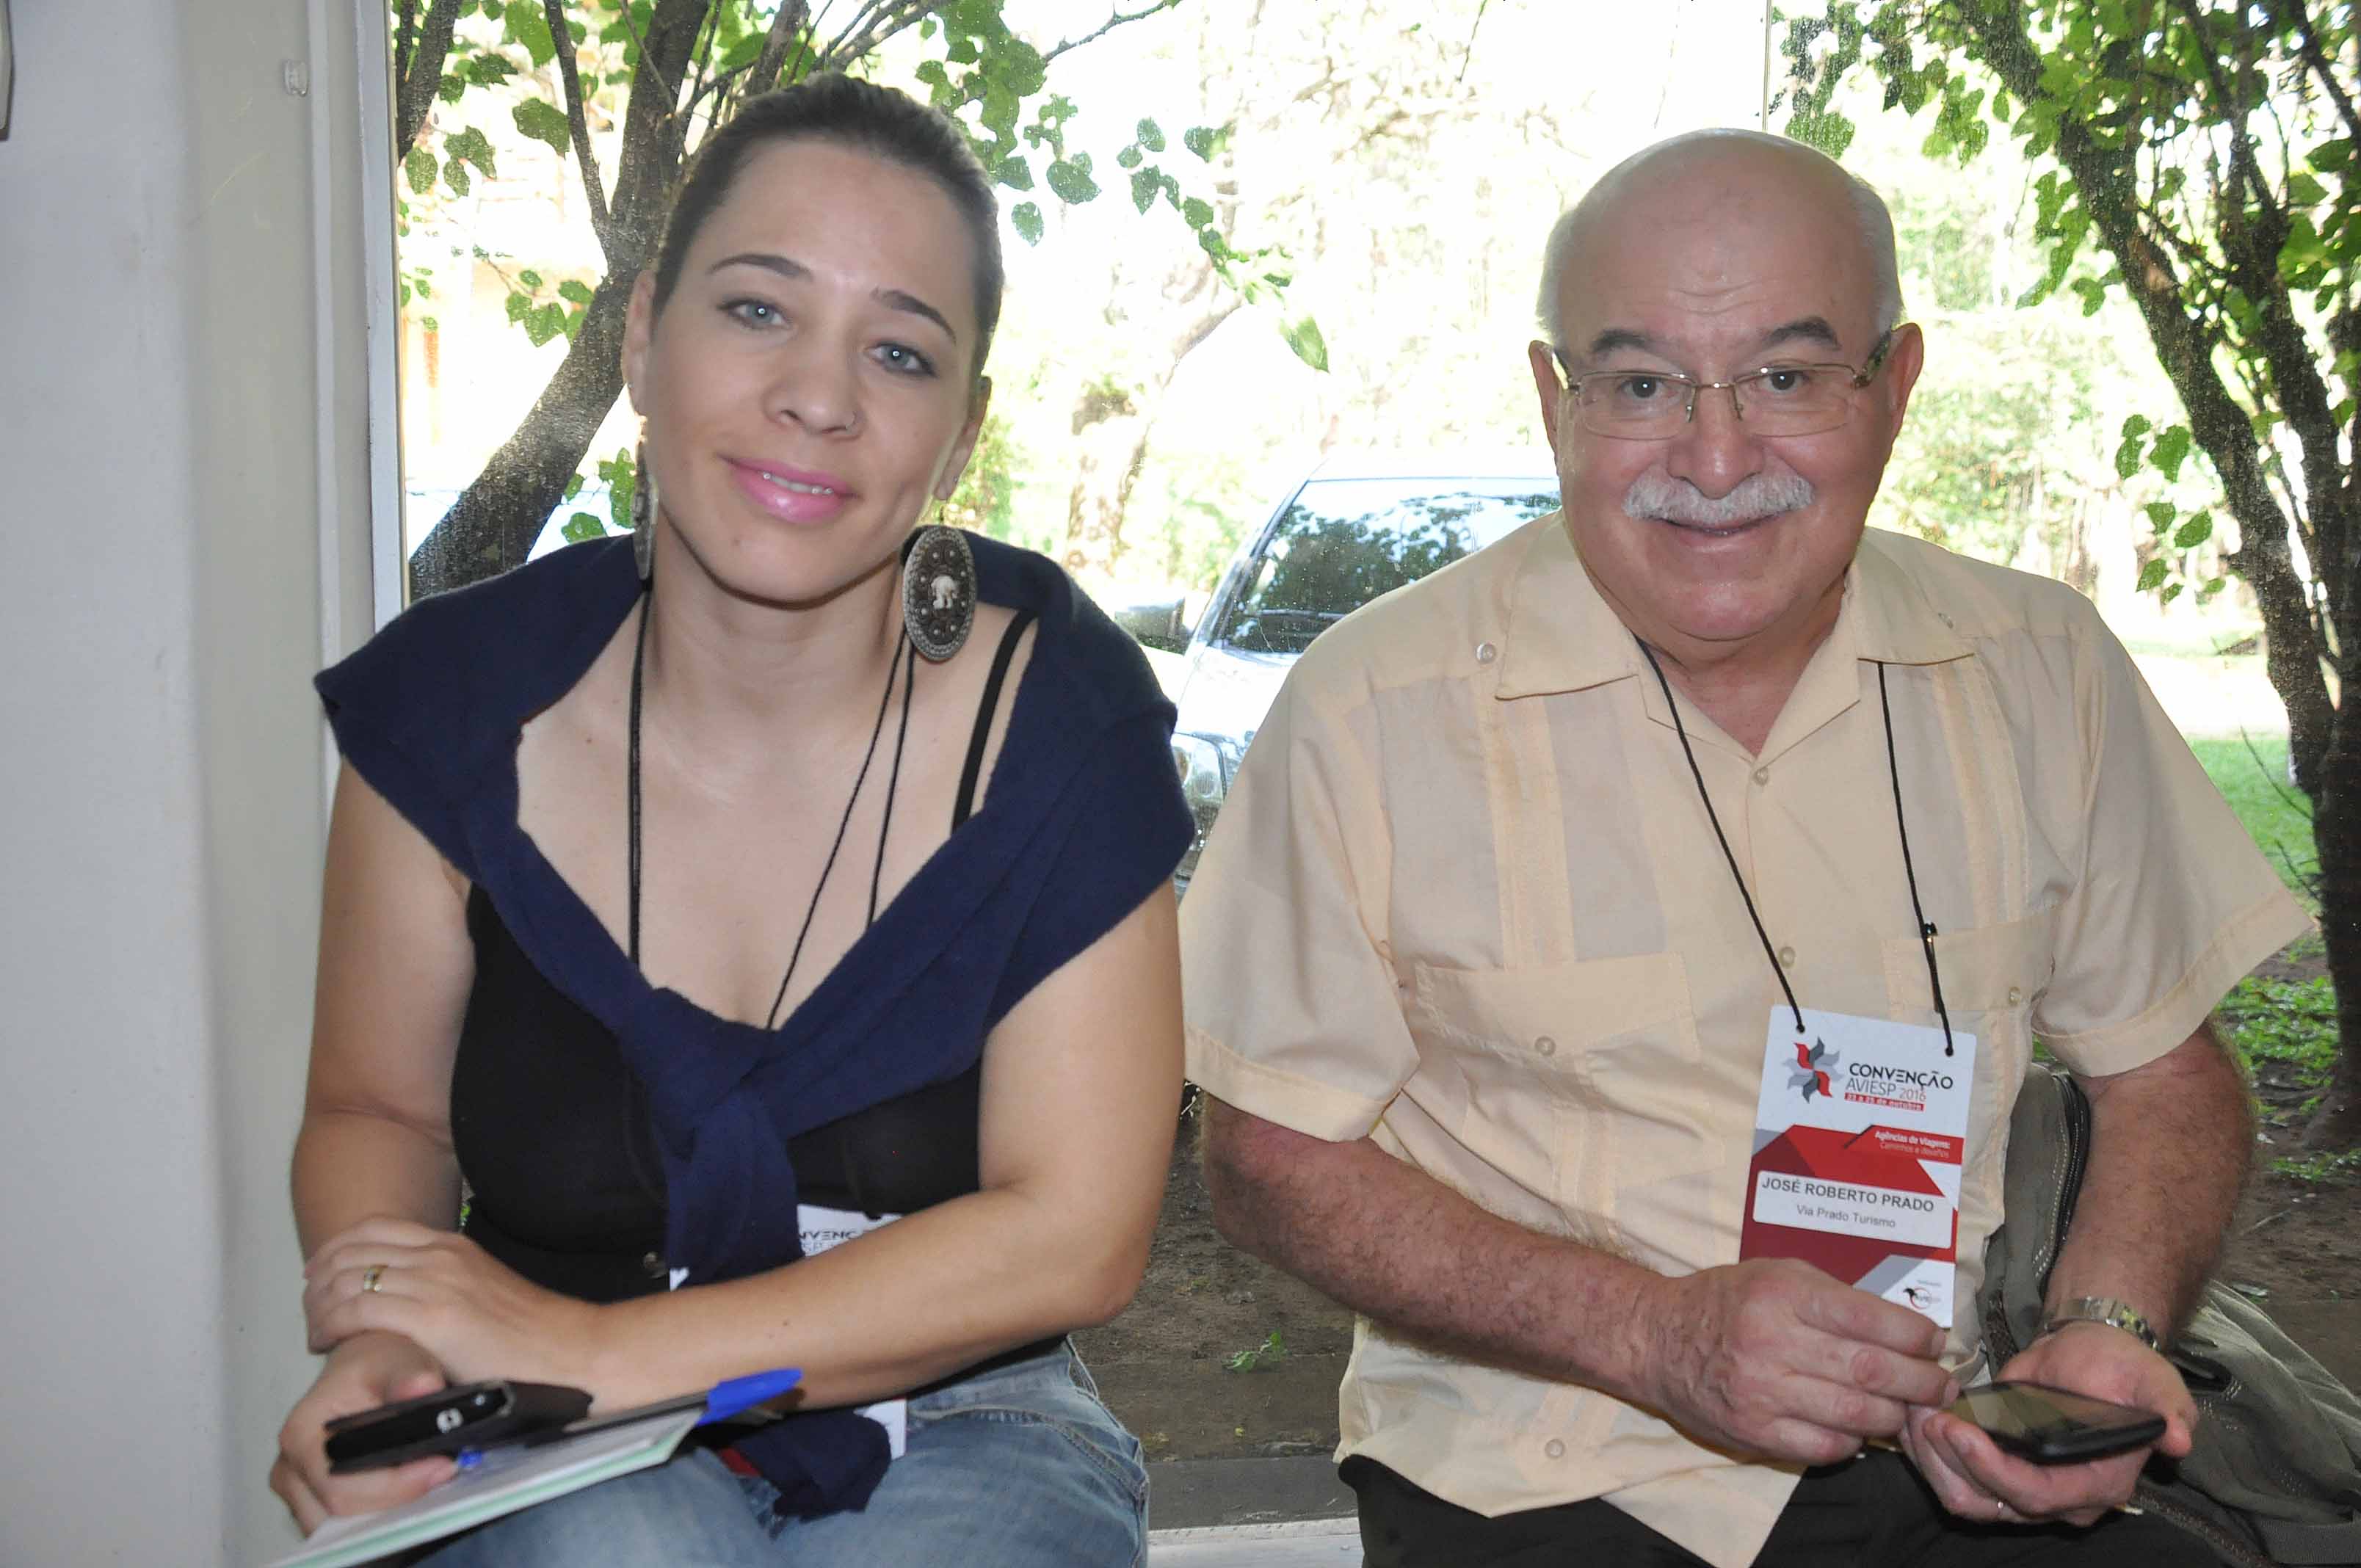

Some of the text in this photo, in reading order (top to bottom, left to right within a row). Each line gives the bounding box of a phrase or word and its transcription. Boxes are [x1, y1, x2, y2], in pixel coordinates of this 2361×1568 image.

[1846, 1078, 1926, 1102] AVIESP 2016
[1849, 1063, 1954, 1092] CONVENÇÃO
[1762, 1177, 1934, 1212] JOSÉ ROBERTO PRADO
[1797, 1205, 1896, 1228] Via Prado Turismo
